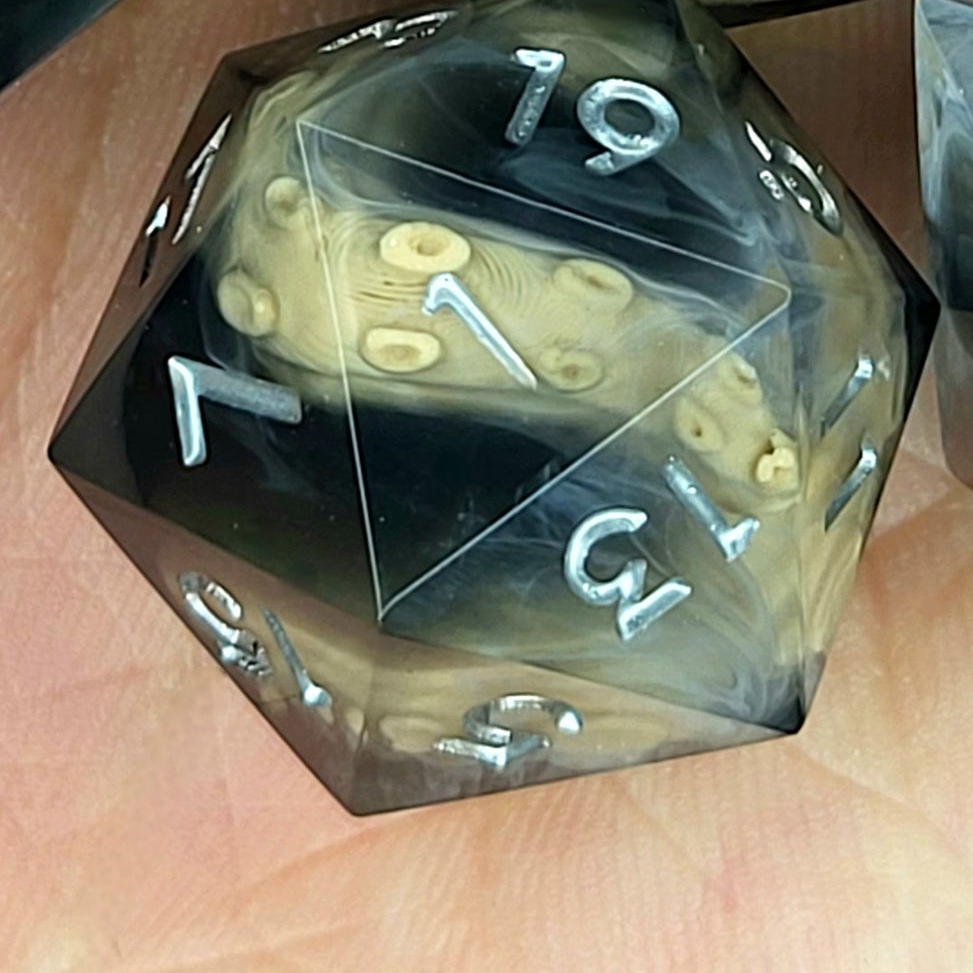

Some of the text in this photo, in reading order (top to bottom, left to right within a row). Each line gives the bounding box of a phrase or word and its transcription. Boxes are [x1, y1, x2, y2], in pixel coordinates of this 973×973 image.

[507, 48, 680, 176] 19
[421, 273, 538, 390] 1
[167, 354, 303, 467] 7
[564, 454, 761, 643] 13
